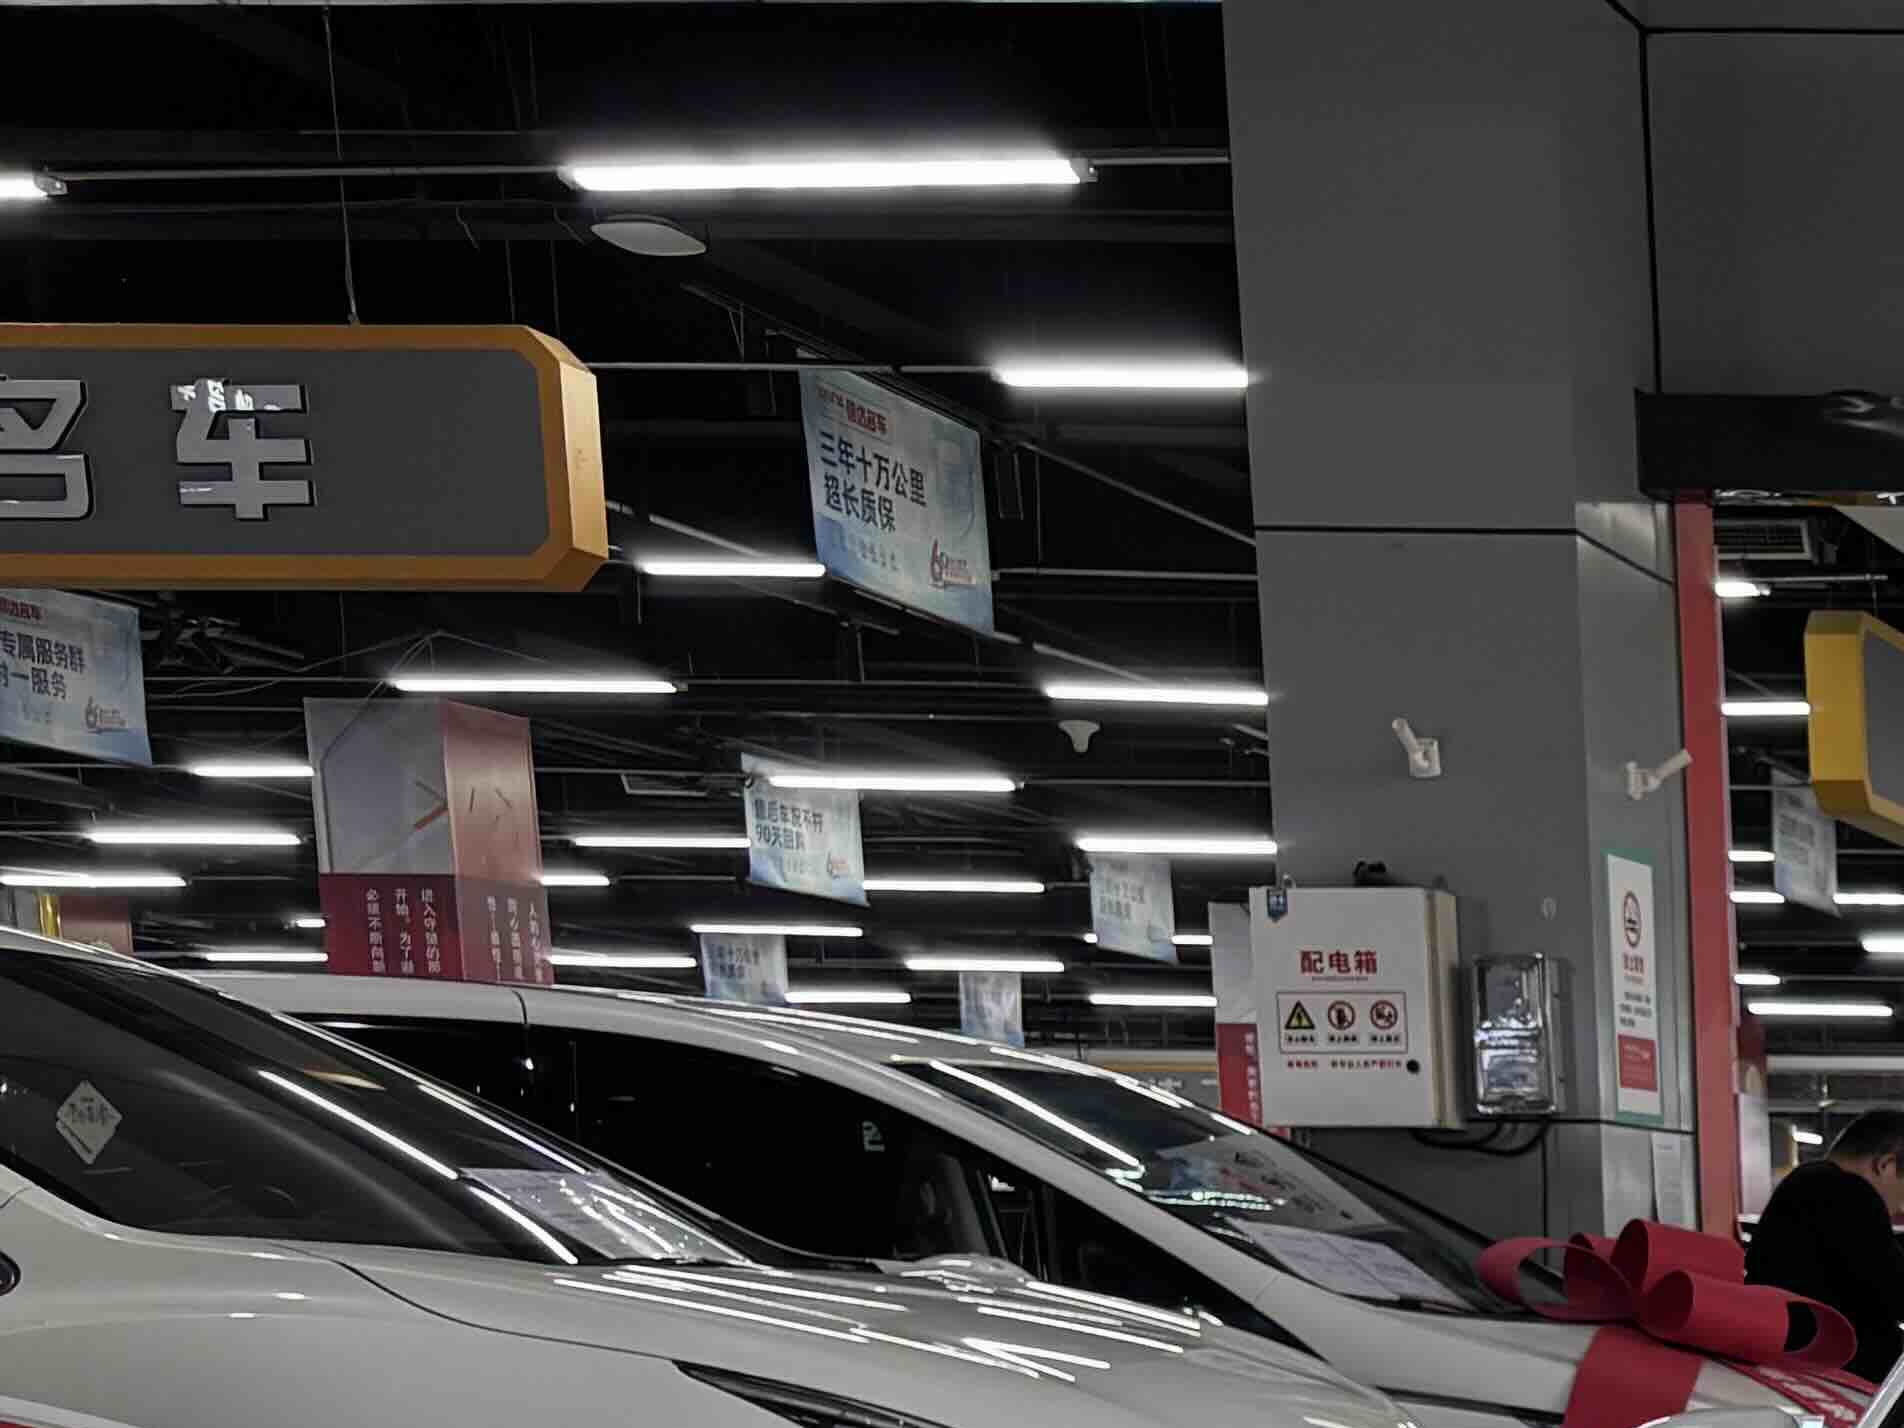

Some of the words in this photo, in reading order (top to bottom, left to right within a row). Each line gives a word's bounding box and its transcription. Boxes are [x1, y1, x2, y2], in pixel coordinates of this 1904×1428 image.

[0, 378, 317, 521] 名车
[819, 430, 928, 507] 三年十万公里
[824, 472, 897, 533] 超长质保
[1299, 950, 1378, 975] 配电箱
